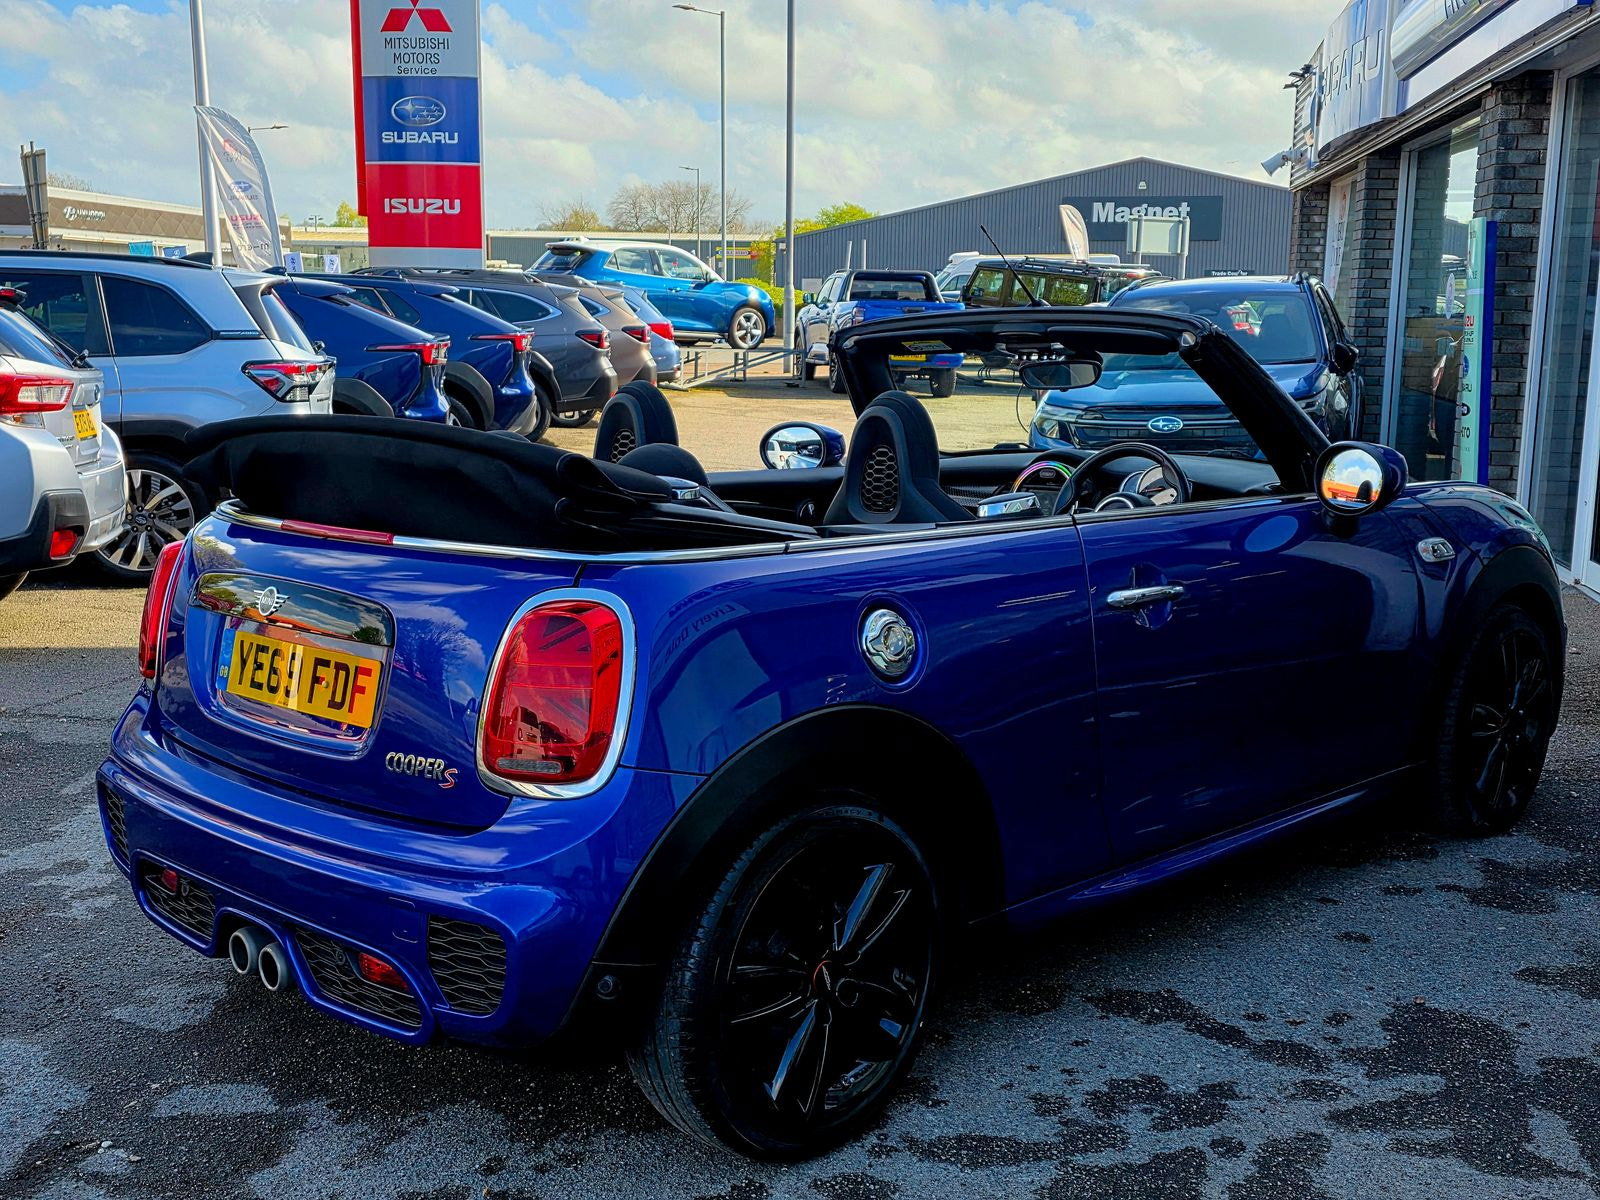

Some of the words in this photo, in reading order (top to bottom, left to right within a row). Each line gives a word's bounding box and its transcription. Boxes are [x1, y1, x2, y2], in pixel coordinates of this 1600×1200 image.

[384, 37, 450, 50] MITSUBISHI
[393, 52, 440, 64] MOTORS
[397, 65, 438, 75] Service
[381, 131, 459, 144] SUBARU
[384, 198, 461, 214] ISUZU
[1092, 201, 1191, 222] Magnet
[238, 640, 304, 699] YE69
[308, 656, 373, 714] FDF
[385, 751, 445, 781] COOPER
[437, 768, 459, 789] S
